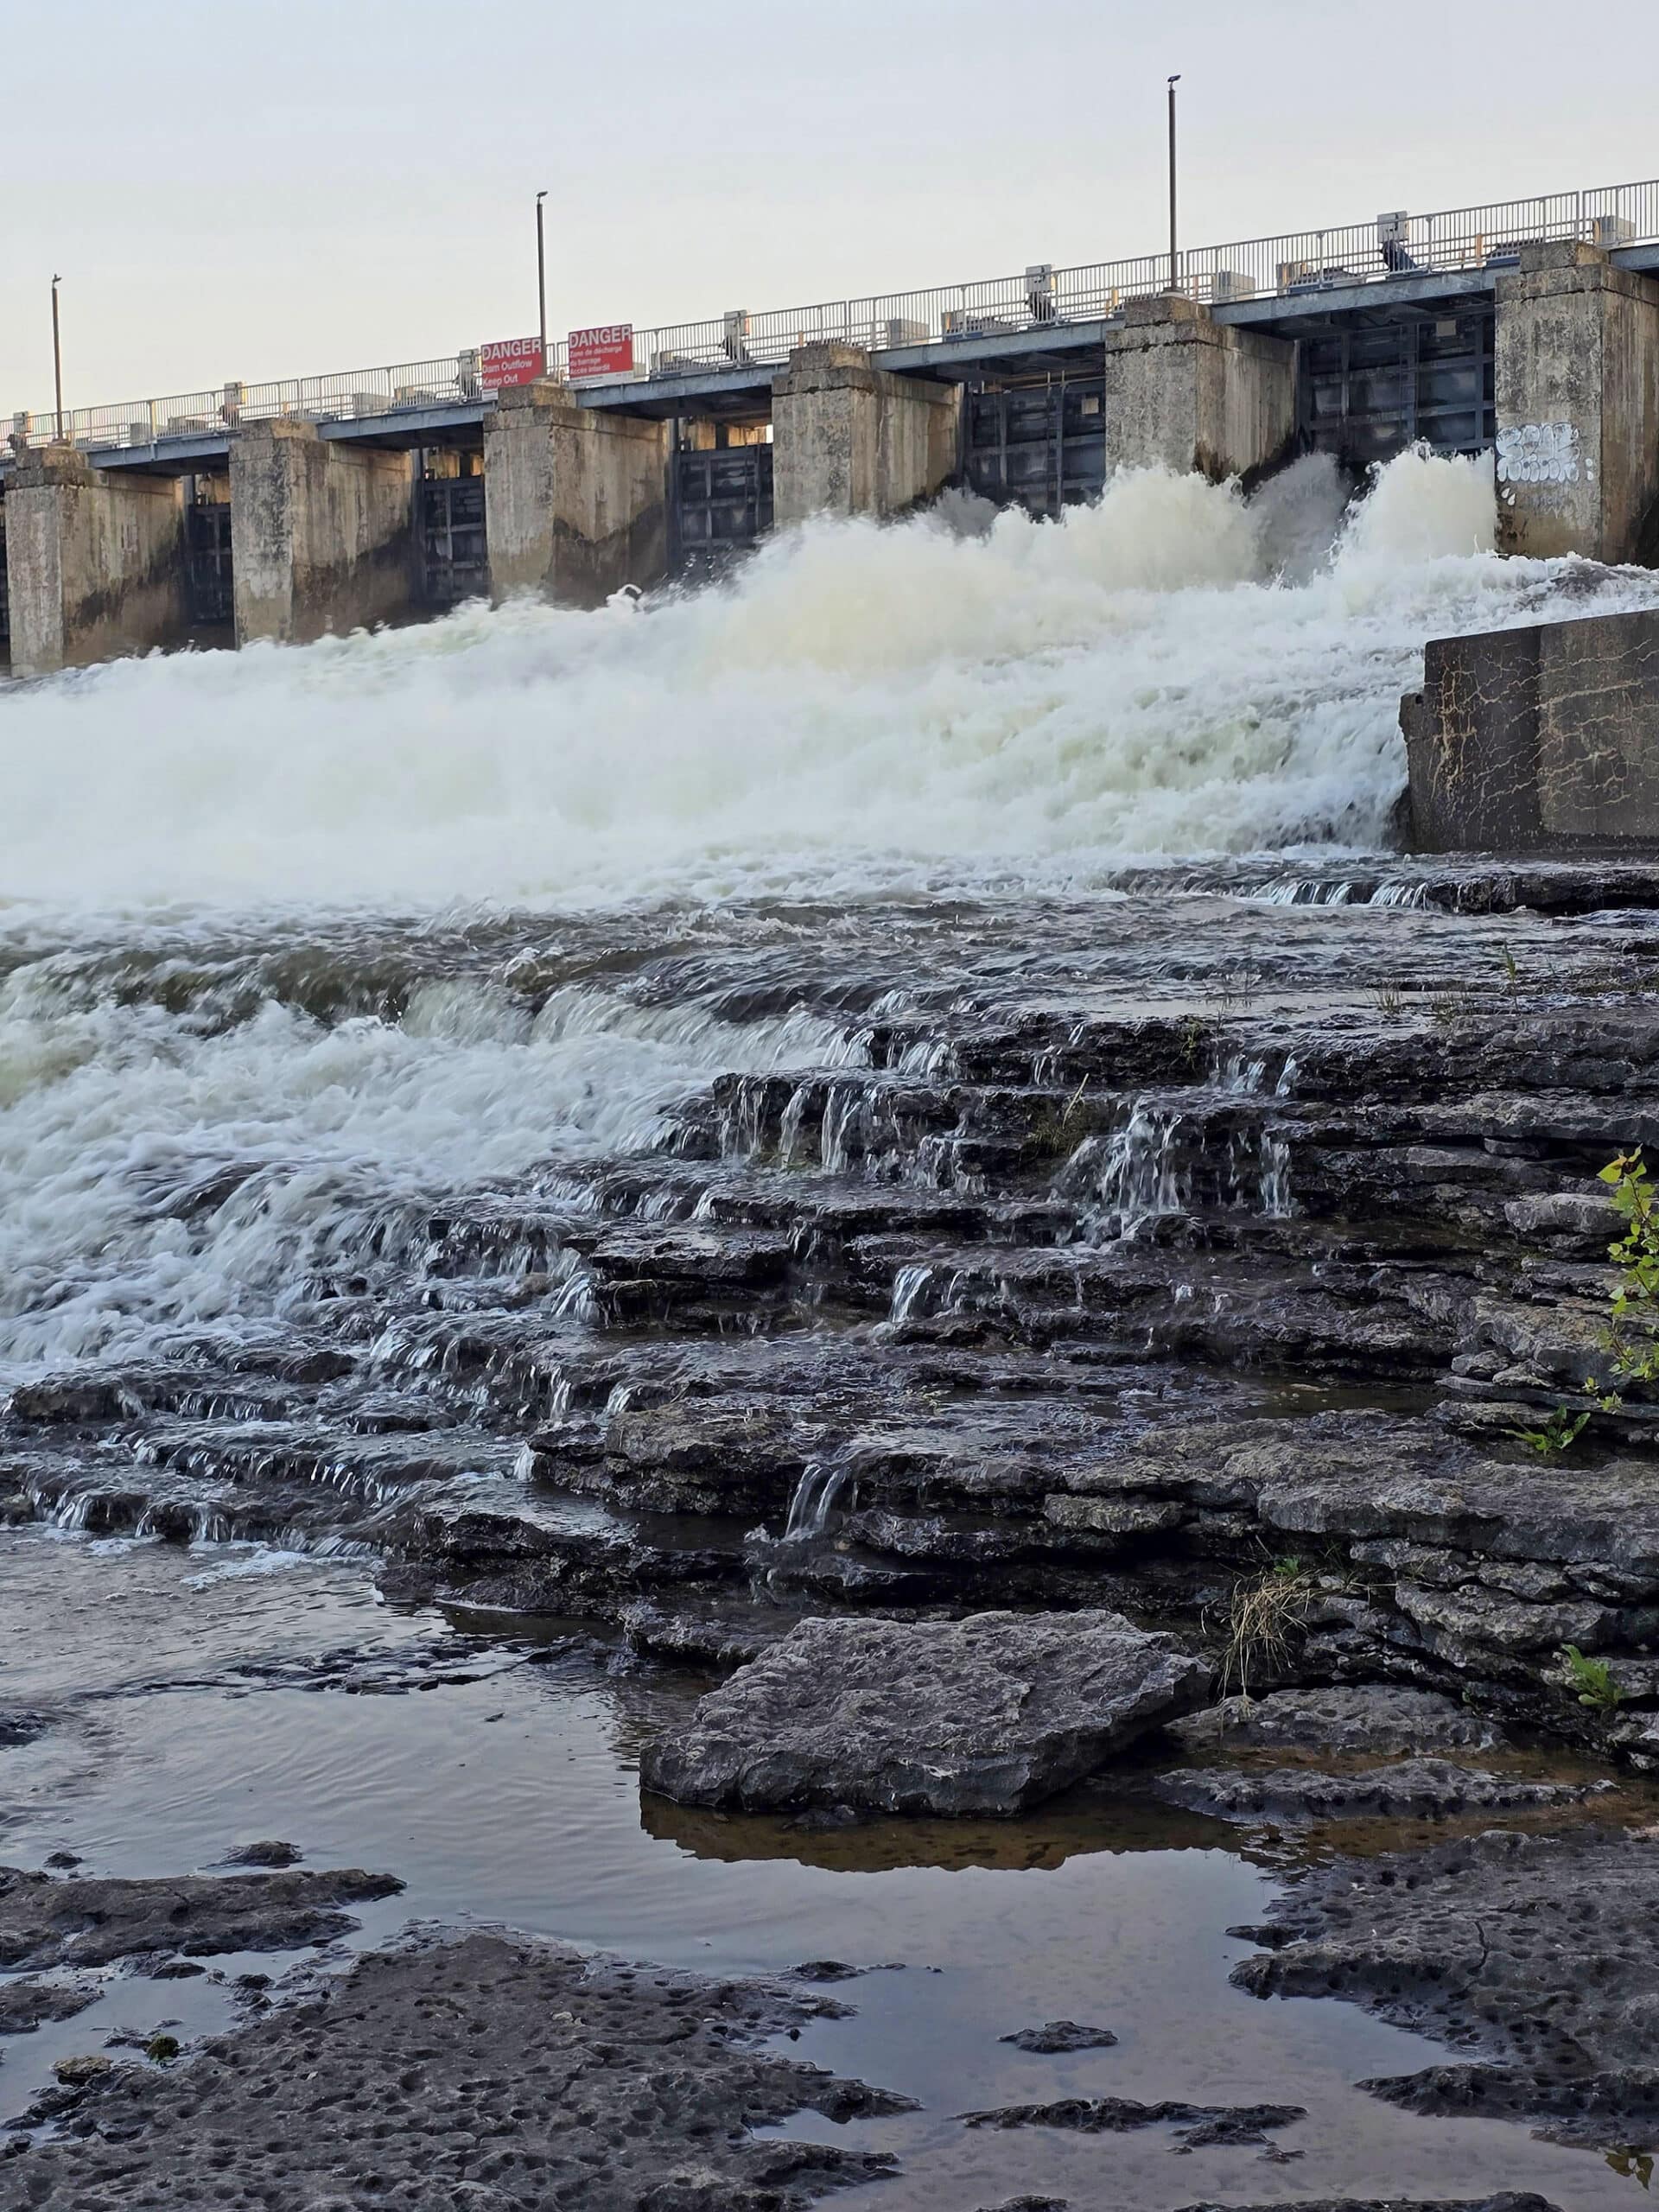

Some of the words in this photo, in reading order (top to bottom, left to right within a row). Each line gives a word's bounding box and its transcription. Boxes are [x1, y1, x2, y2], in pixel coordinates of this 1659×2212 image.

[569, 325, 632, 348] DANGER
[482, 338, 541, 361] DANGER
[569, 350, 584, 359] Zone
[482, 364, 499, 373] Dam
[501, 359, 533, 371] Outflow
[577, 358, 601, 366] barrage
[588, 364, 610, 372] interdit
[482, 377, 502, 388] Keep
[504, 373, 518, 385] Out
